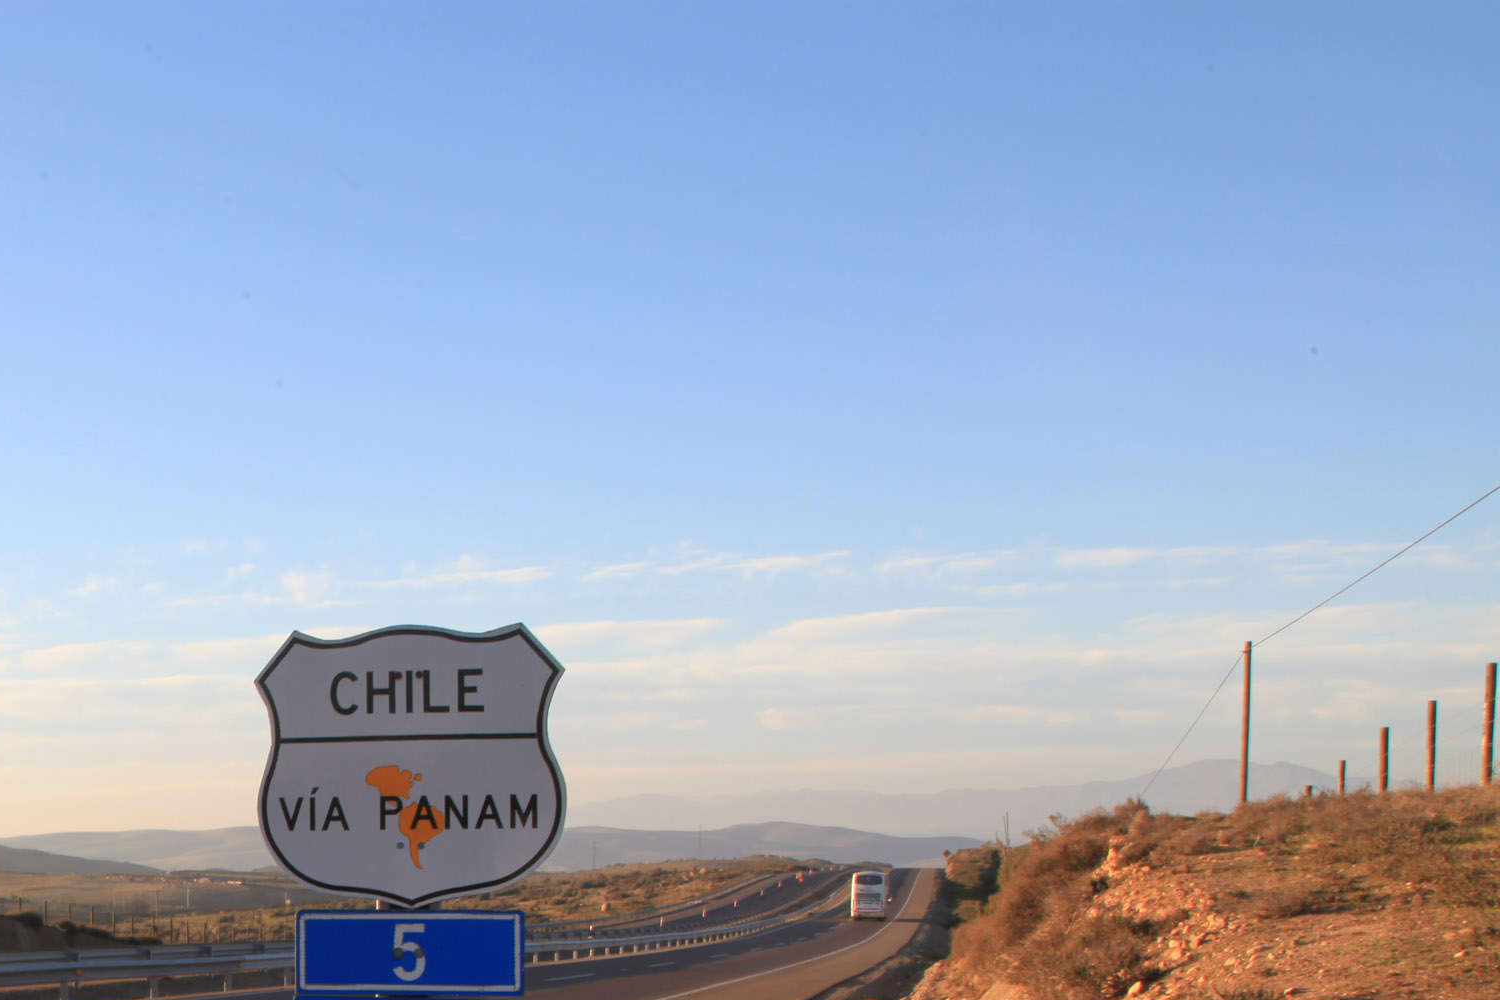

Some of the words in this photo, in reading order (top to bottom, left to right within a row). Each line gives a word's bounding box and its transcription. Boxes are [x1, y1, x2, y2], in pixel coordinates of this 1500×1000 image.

[330, 668, 484, 715] CHILE
[279, 787, 350, 832] VÍA
[380, 794, 538, 831] PANAM
[392, 923, 426, 982] 5
